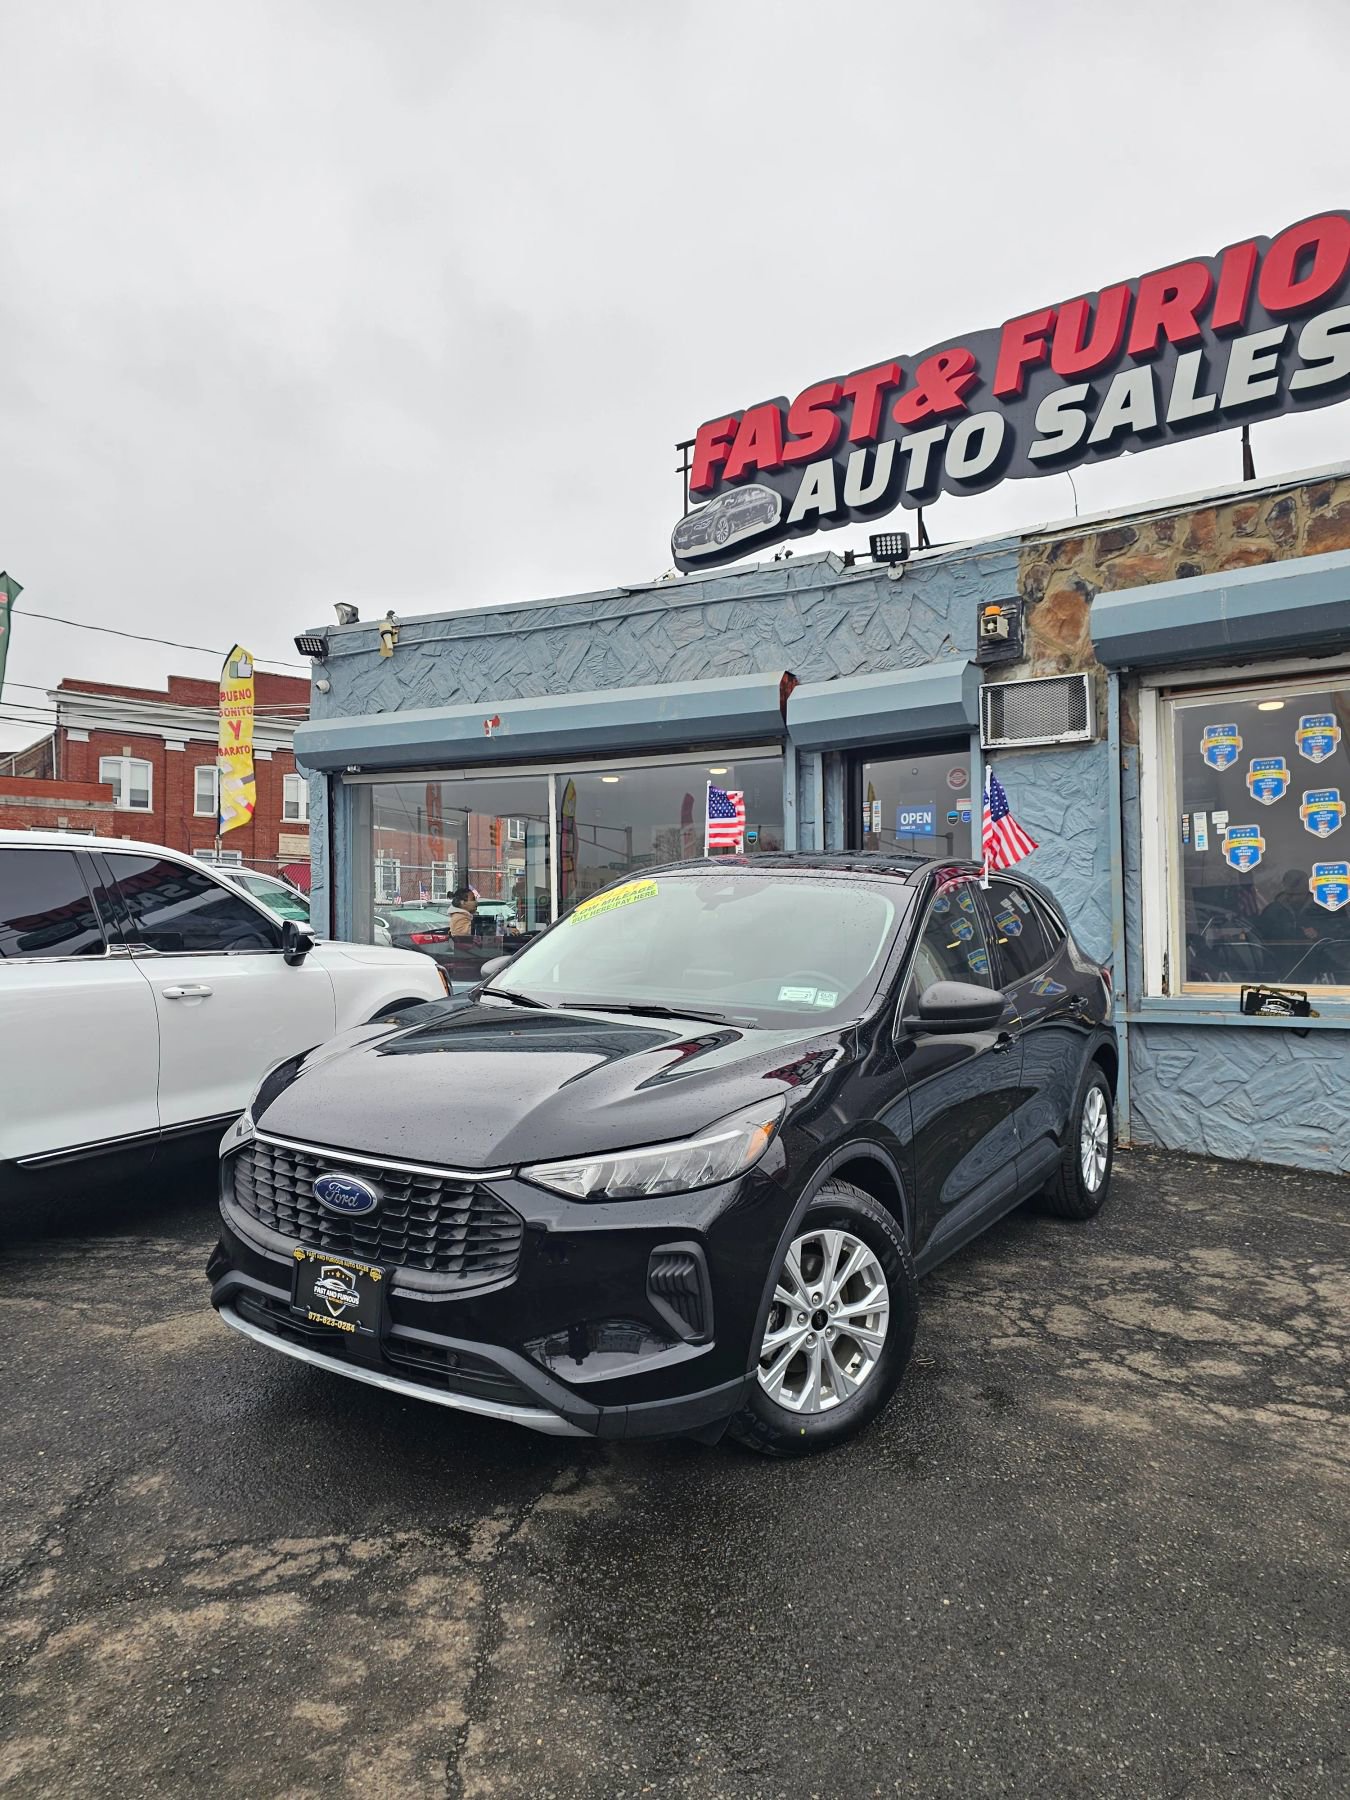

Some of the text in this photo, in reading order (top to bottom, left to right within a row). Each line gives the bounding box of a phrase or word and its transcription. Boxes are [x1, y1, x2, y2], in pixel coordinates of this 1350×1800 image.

[690, 362, 902, 492] FAST
[993, 215, 1350, 397] FURIO
[786, 304, 1350, 523] AUTO SALES
[219, 688, 252, 702] BUENO
[218, 706, 253, 717] BONITO
[228, 720, 242, 741] Y
[218, 745, 251, 757] BARATO
[901, 811, 932, 825] OPEN
[601, 885, 656, 906] MILEAGE
[572, 914, 589, 924] BUY
[634, 890, 657, 901] HERE
[325, 1182, 360, 1207] Ford
[306, 1250, 317, 1258] FAST
[326, 1256, 344, 1265] FURIOUS
[314, 1286, 326, 1294] FAST
[326, 1289, 337, 1298] AND
[337, 1292, 359, 1305] FURIOUS
